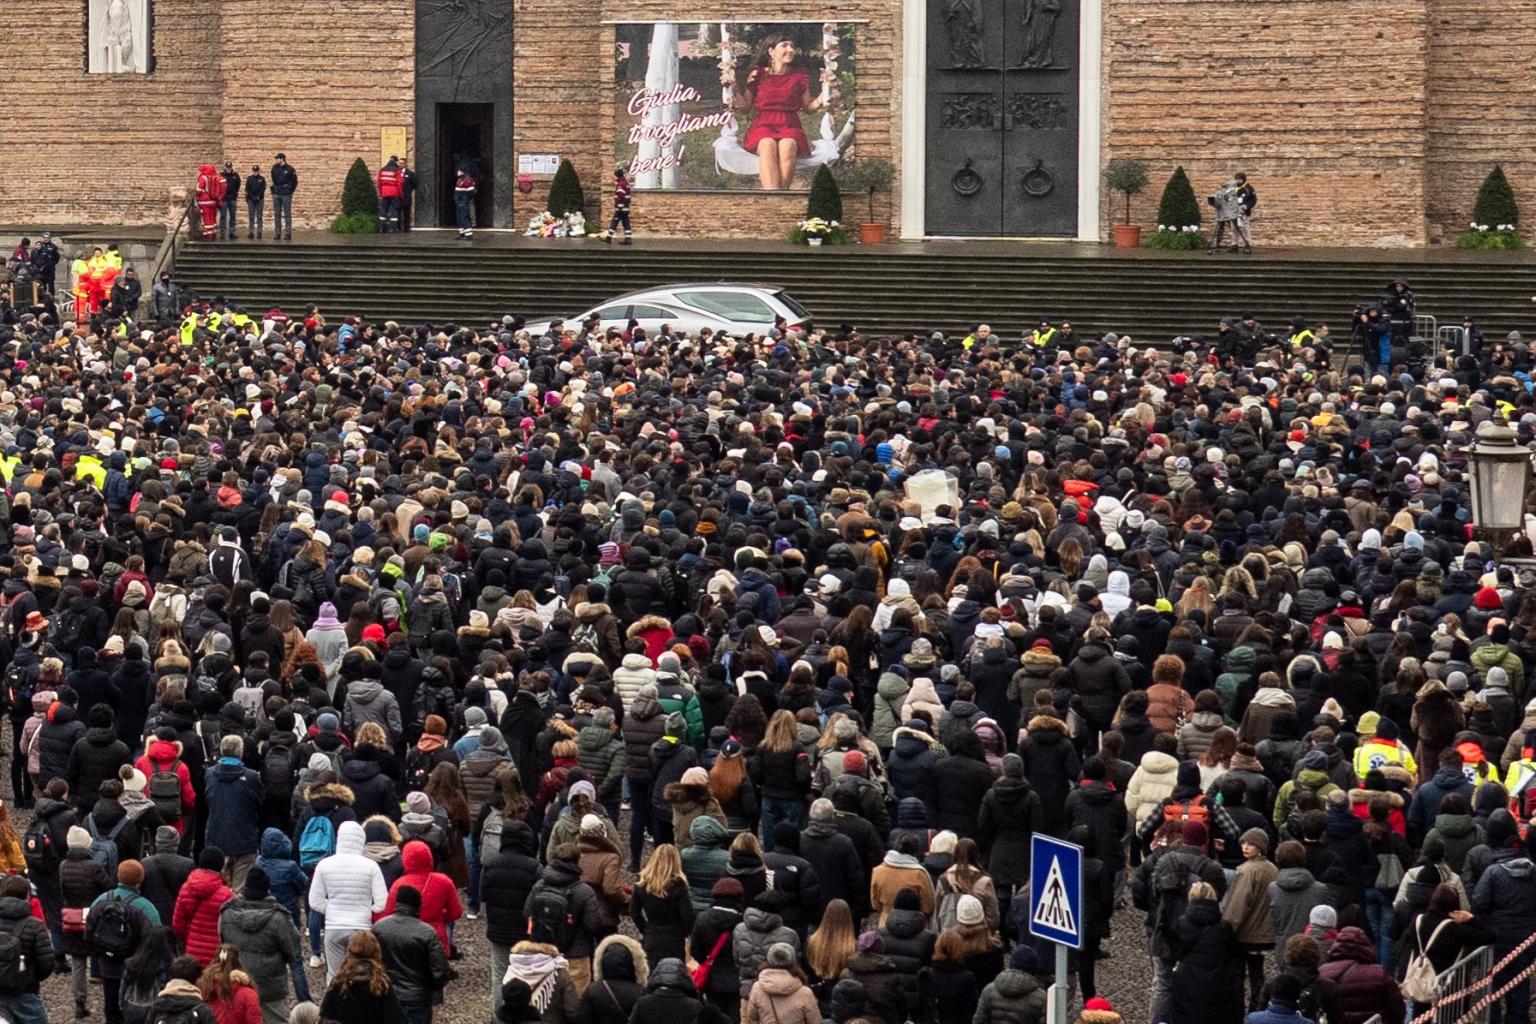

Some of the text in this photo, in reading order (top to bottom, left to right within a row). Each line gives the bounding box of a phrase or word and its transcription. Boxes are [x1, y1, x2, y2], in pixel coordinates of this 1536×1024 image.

[627, 83, 701, 119] Giulia,
[628, 111, 732, 148] ti vogliamo
[628, 145, 685, 175] bene!
